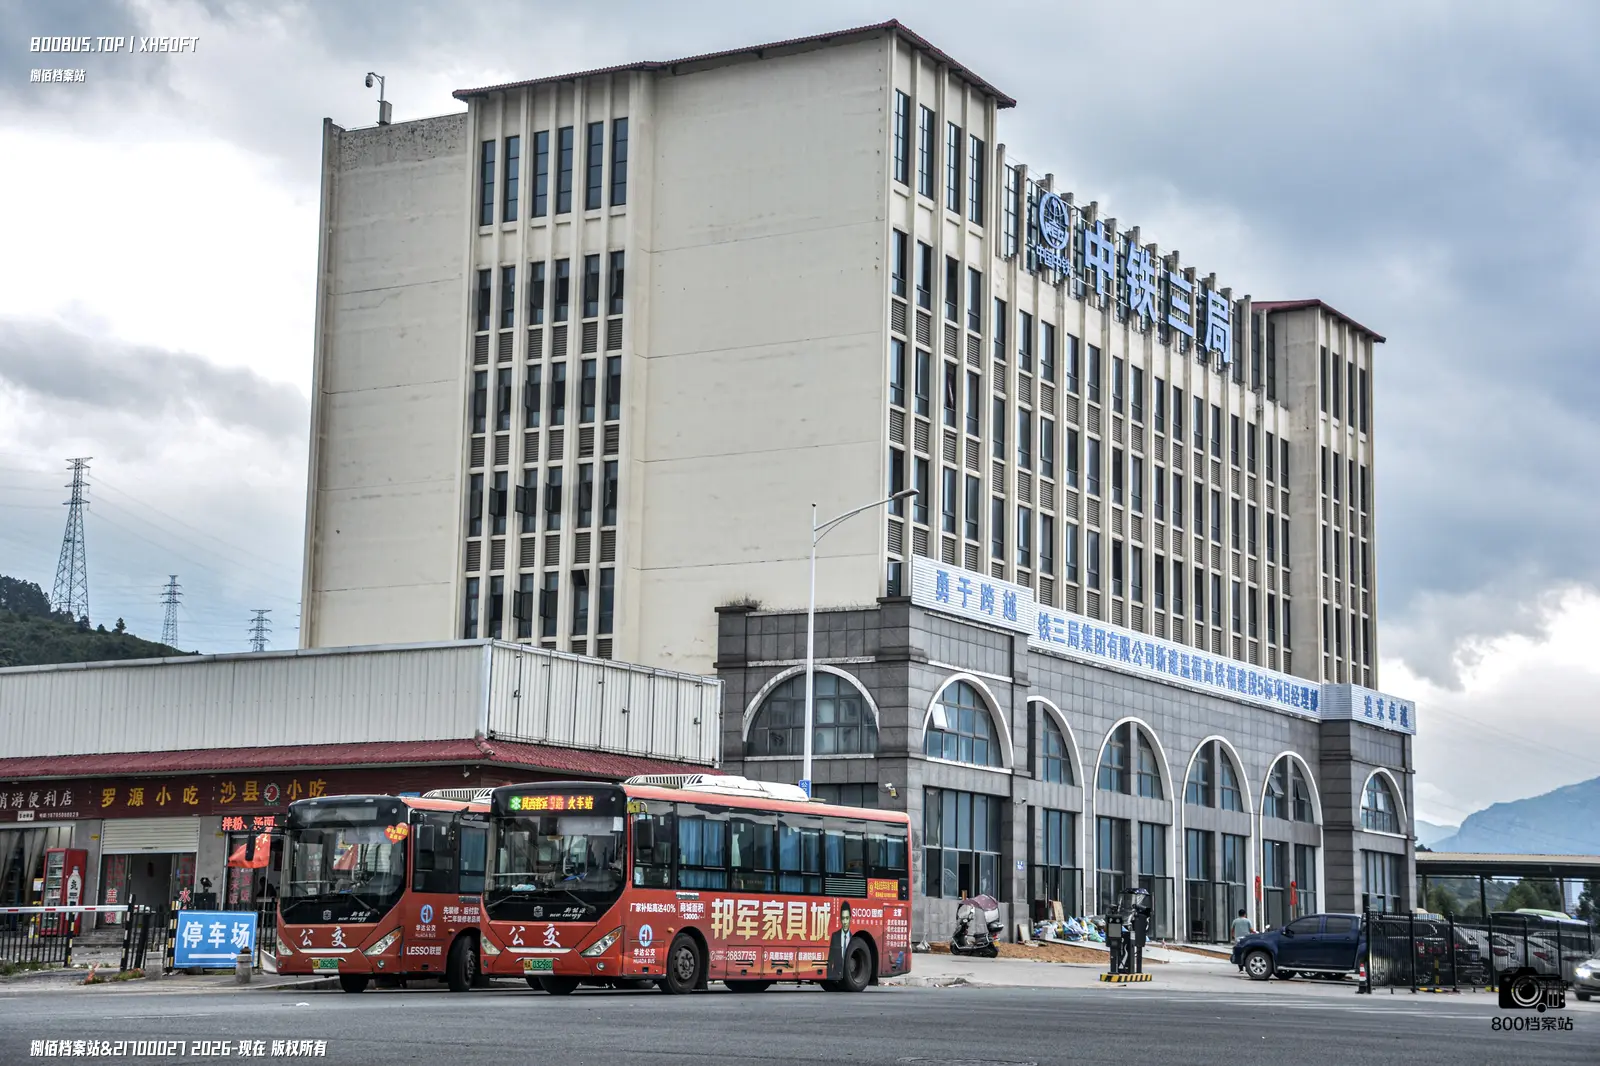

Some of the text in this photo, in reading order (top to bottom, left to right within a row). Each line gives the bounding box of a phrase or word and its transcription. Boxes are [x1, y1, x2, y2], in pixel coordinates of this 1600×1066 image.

[1036, 244, 1070, 276] 中国中铁
[1084, 220, 1231, 364] 中铁三局
[935, 569, 1018, 622] 勇于跨越
[1363, 695, 1410, 728] 追求卓越
[101, 785, 199, 808] 罗源小吃
[220, 778, 327, 804] 沙县 小吃
[568, 796, 594, 810] 火车站
[630, 902, 676, 913] 厂家补贴高达40%
[711, 898, 831, 941] 邦军家具城
[182, 921, 250, 949] 停车场
[299, 925, 347, 948] 公交
[508, 923, 561, 948] 公交
[633, 948, 656, 956] 华达公交
[726, 951, 756, 960] 26837755
